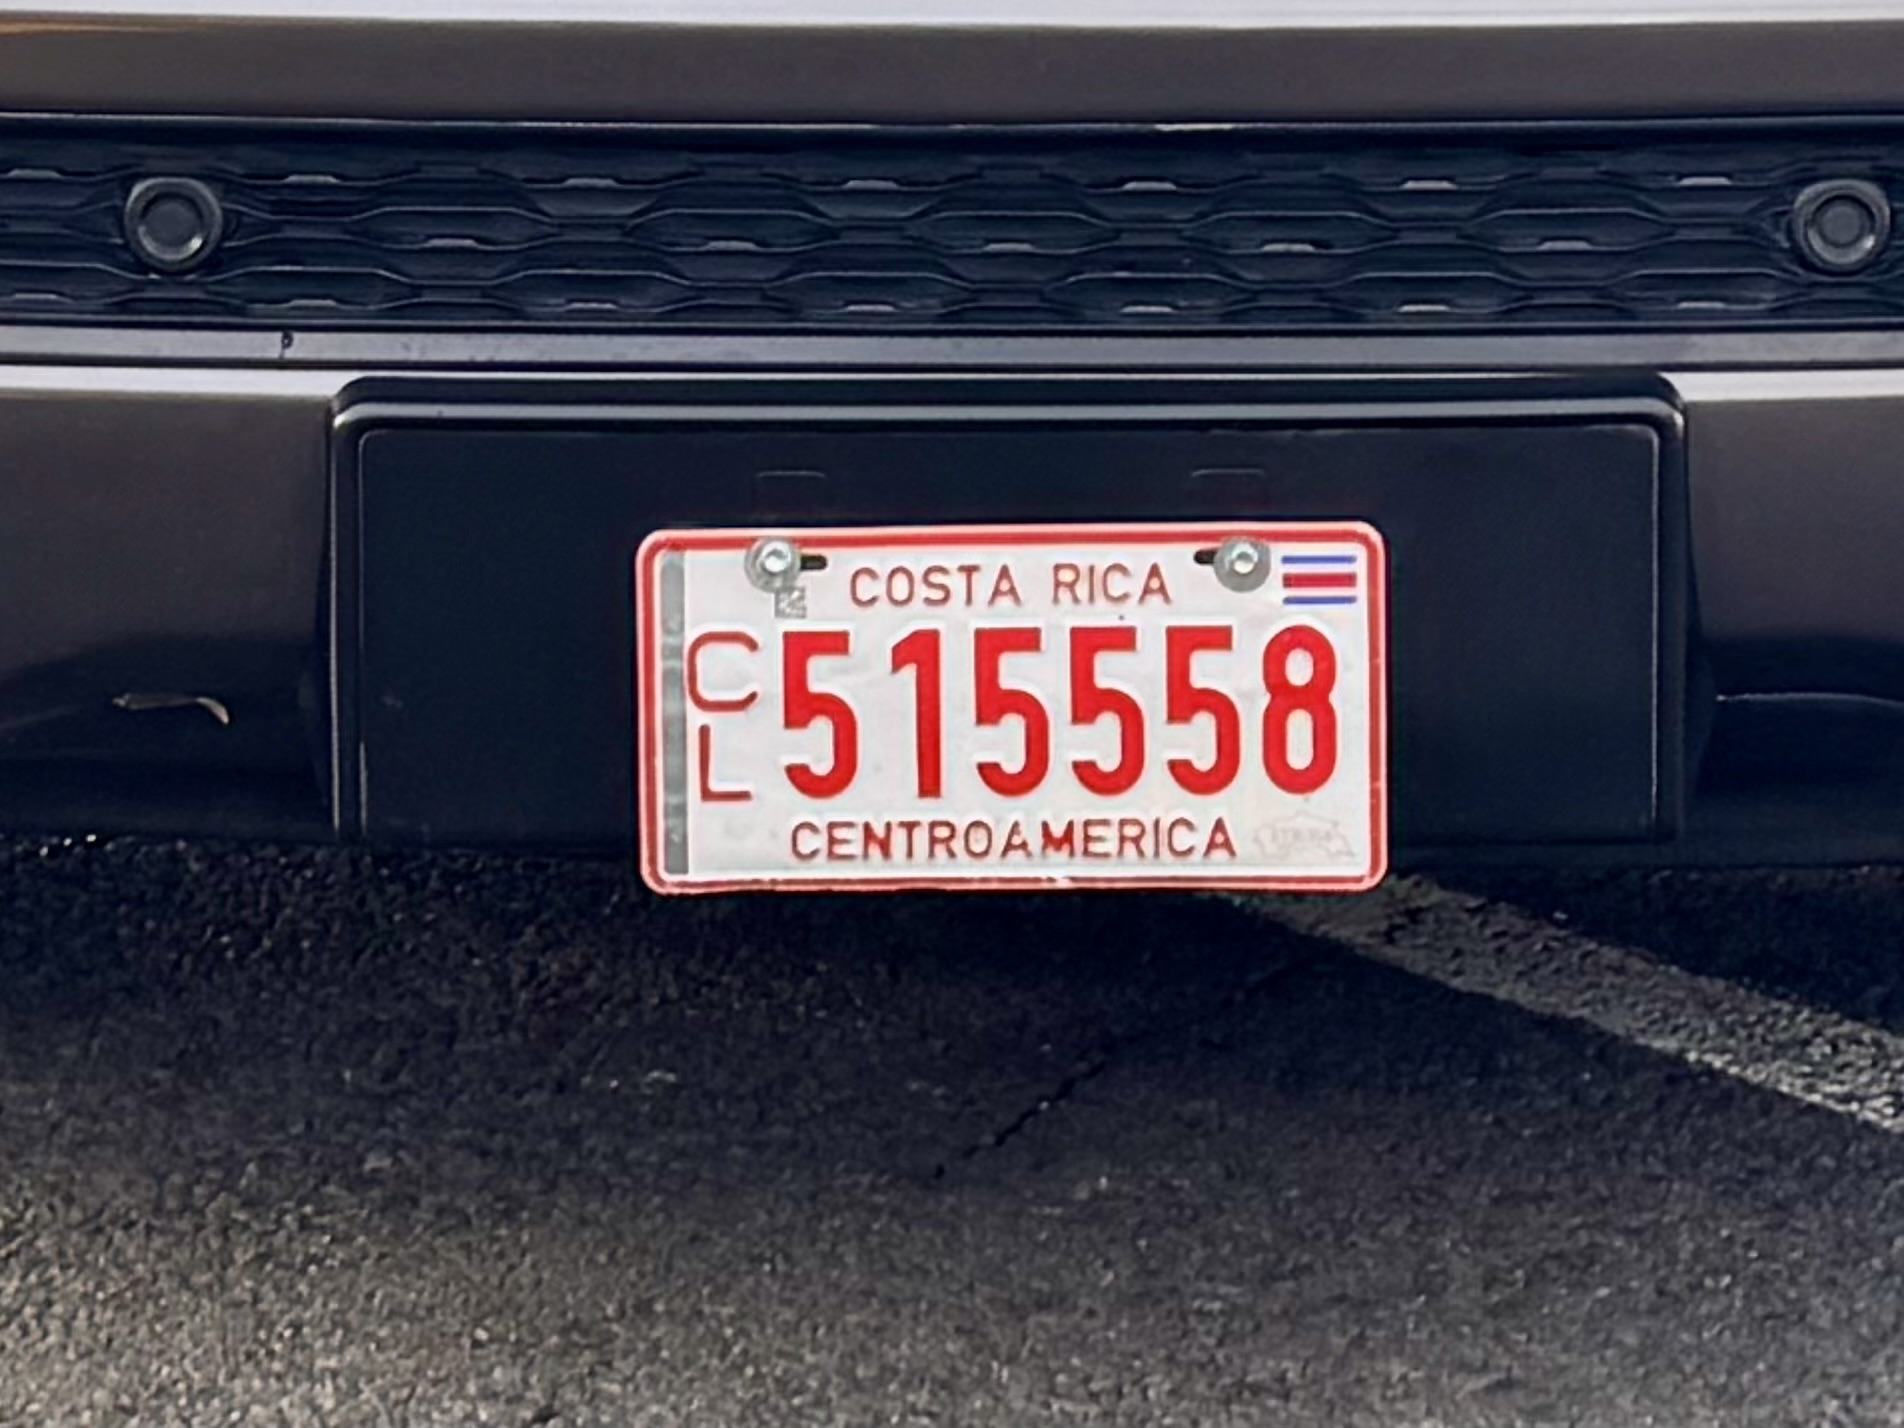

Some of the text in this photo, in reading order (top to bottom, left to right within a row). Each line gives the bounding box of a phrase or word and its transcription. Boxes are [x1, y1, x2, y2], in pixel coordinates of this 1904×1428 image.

[849, 562, 1172, 607] COSTA RICA
[781, 626, 1337, 799] 515558
[791, 817, 1237, 861] CENTROAMERICA
